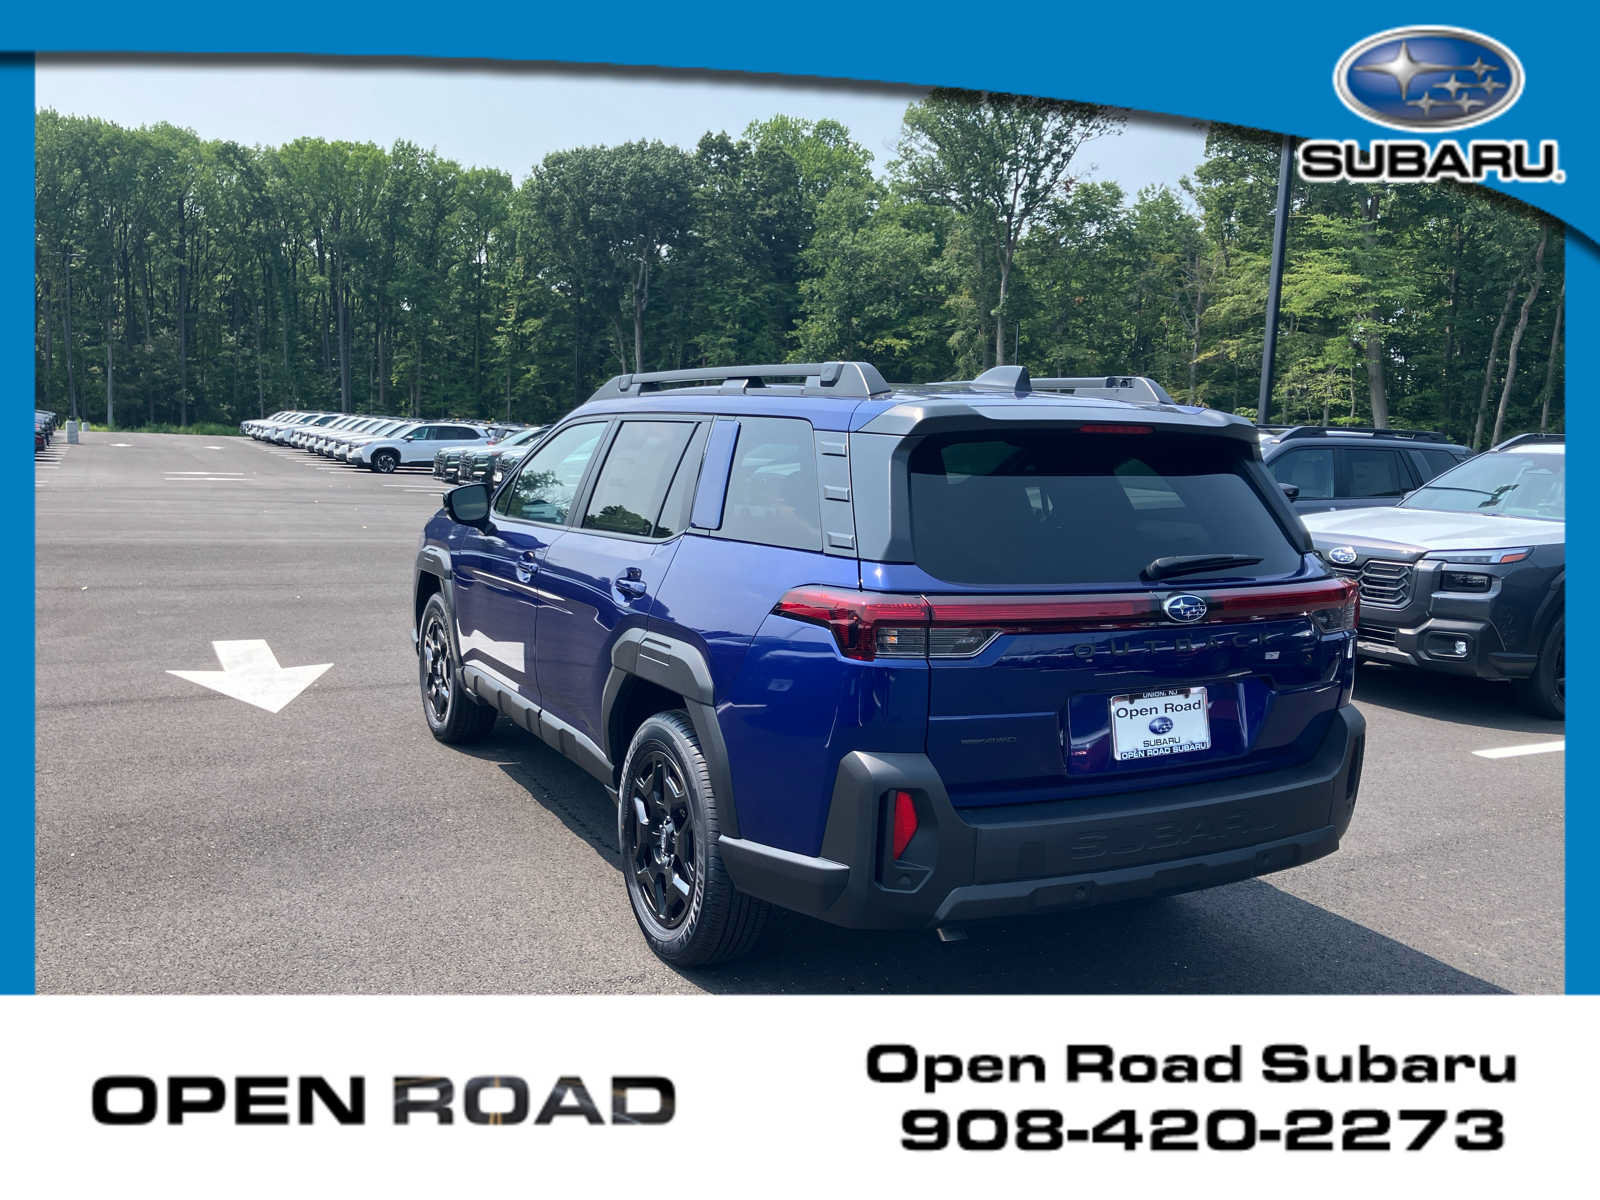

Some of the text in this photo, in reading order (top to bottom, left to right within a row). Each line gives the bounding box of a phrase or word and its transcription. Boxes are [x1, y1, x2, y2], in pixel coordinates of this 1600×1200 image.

[1168, 688, 1178, 696] NJ
[1116, 700, 1201, 719] Open Road
[1143, 737, 1181, 747] SUBARU
[1121, 742, 1207, 760] OPEN ROAD SUBARU
